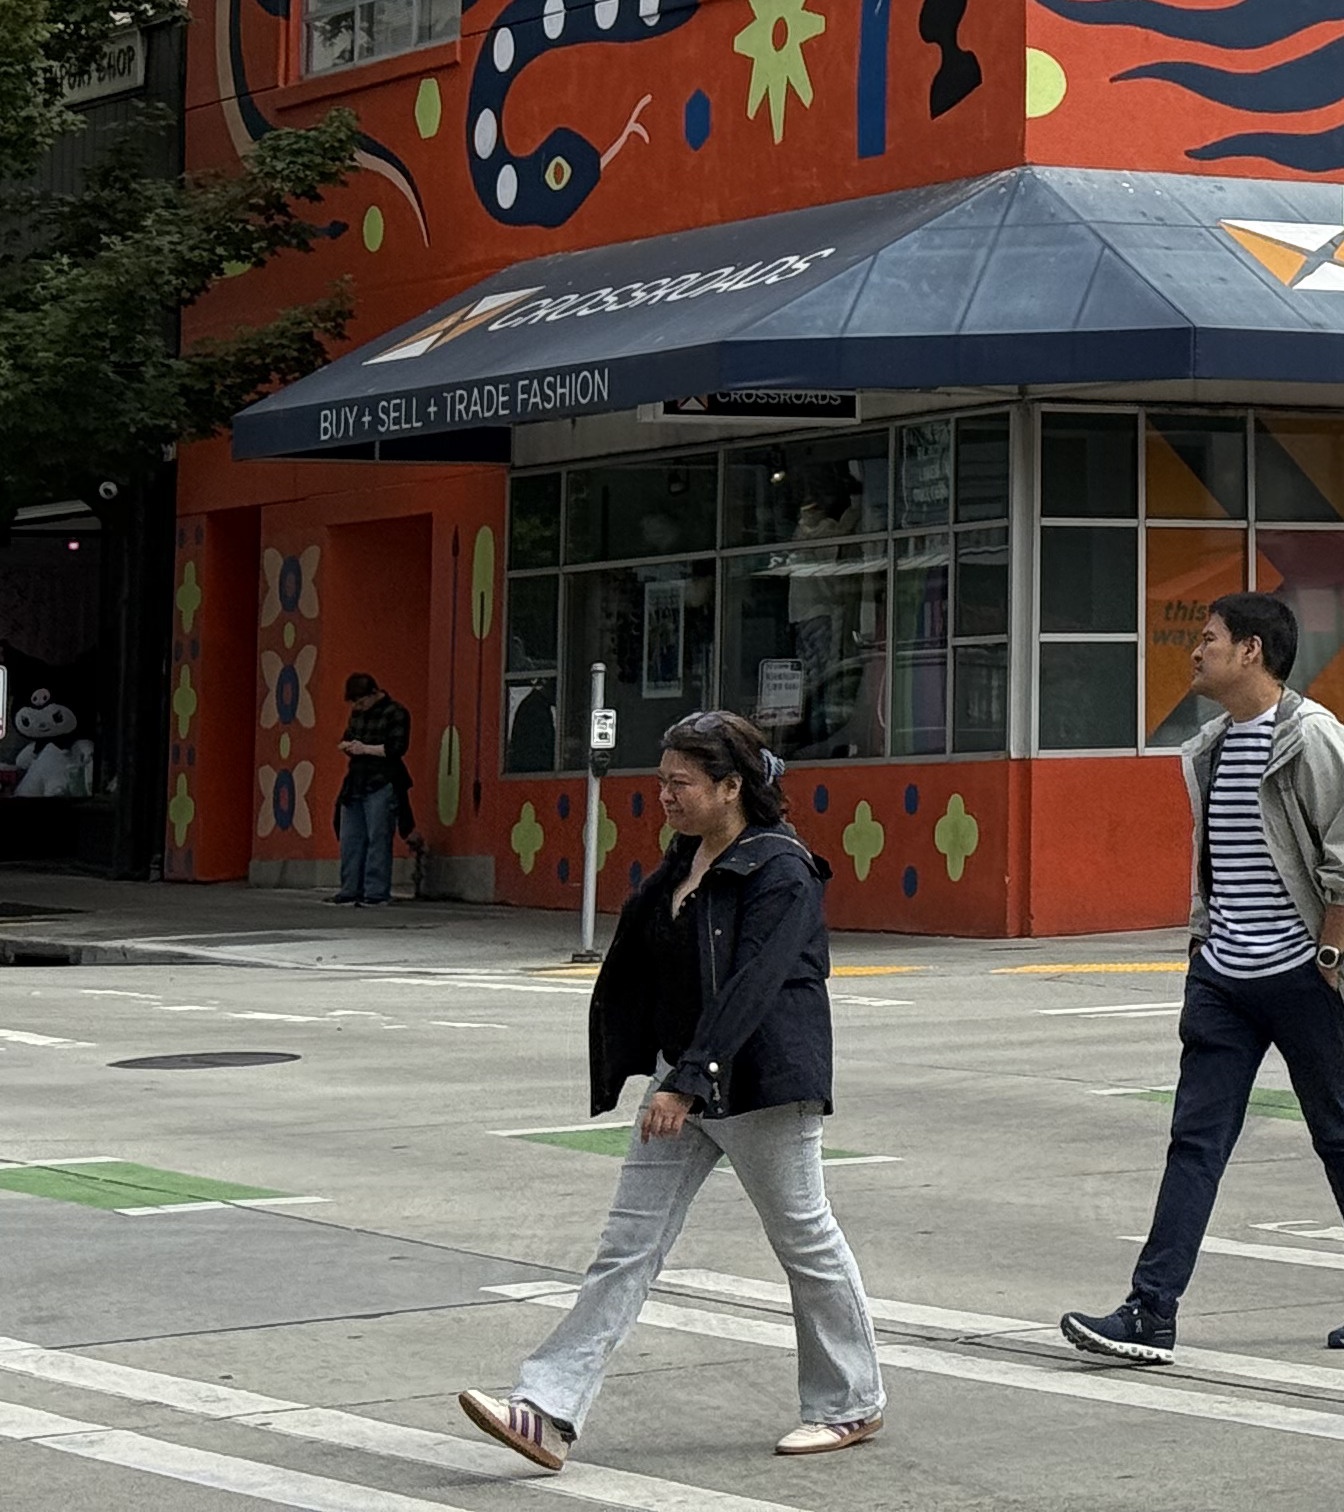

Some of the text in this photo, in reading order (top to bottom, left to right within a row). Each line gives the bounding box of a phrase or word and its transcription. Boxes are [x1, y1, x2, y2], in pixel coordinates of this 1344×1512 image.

[488, 247, 836, 332] CROSSROADS
[320, 405, 359, 441] BUY
[377, 397, 423, 433] SELL
[443, 383, 510, 423] TRADE
[516, 367, 609, 414] FASHION
[716, 390, 842, 405] CROSSROADS
[1164, 600, 1208, 622] this
